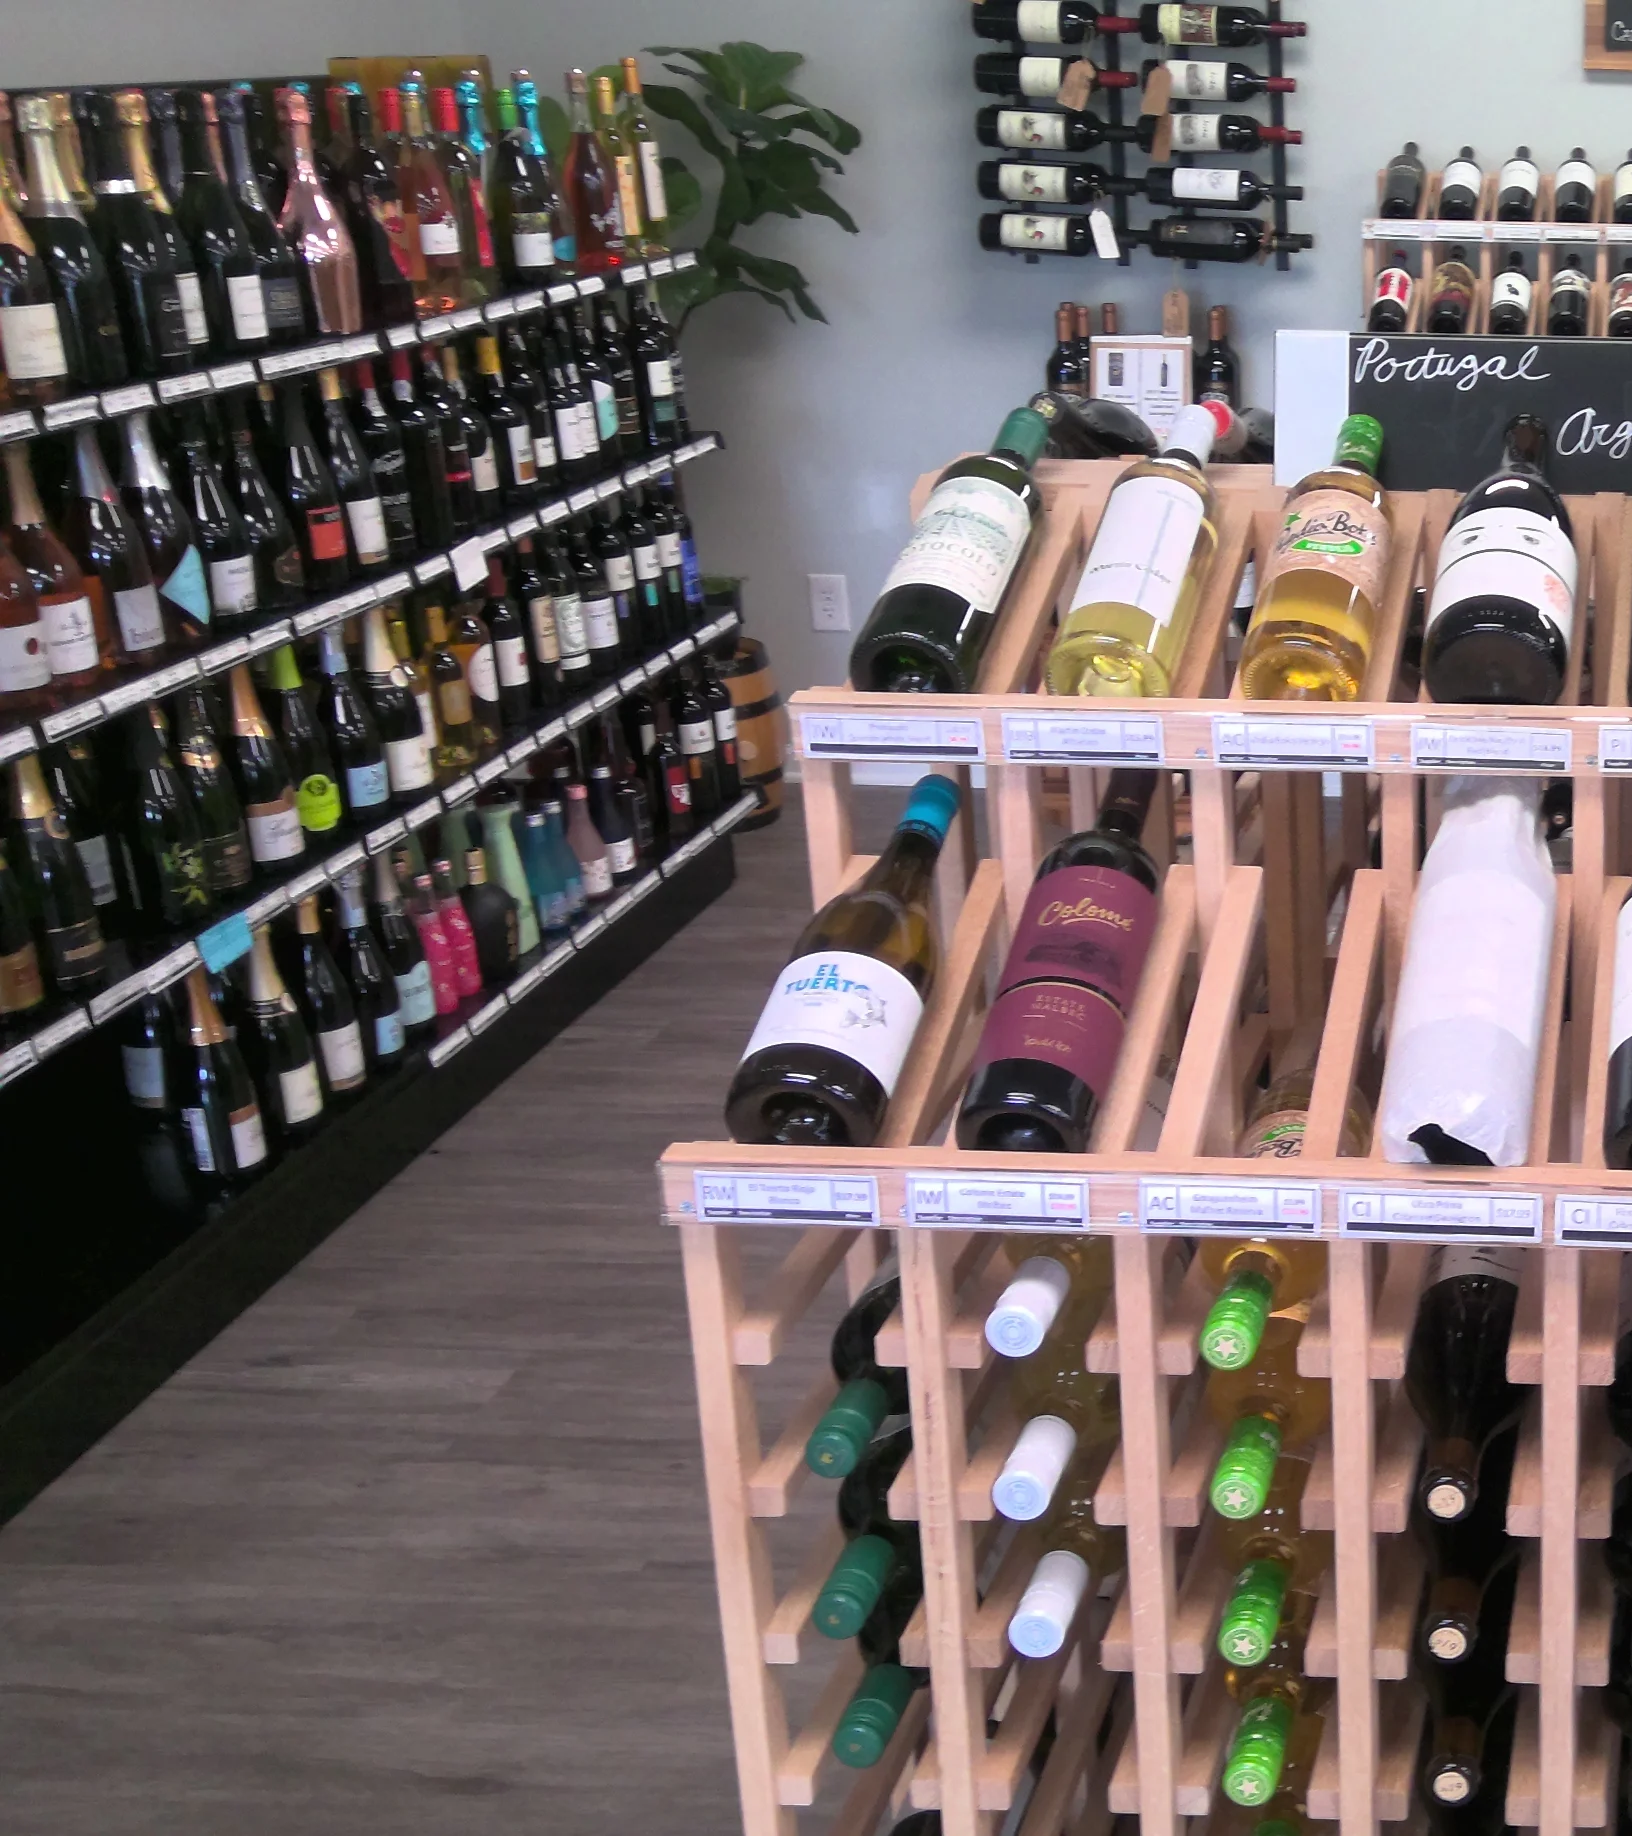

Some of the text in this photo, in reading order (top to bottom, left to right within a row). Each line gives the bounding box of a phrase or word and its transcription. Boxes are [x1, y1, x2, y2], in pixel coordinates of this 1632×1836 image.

[1354, 337, 1552, 391] Portugal
[815, 963, 840, 977] EL
[1148, 1196, 1175, 1211] AC
